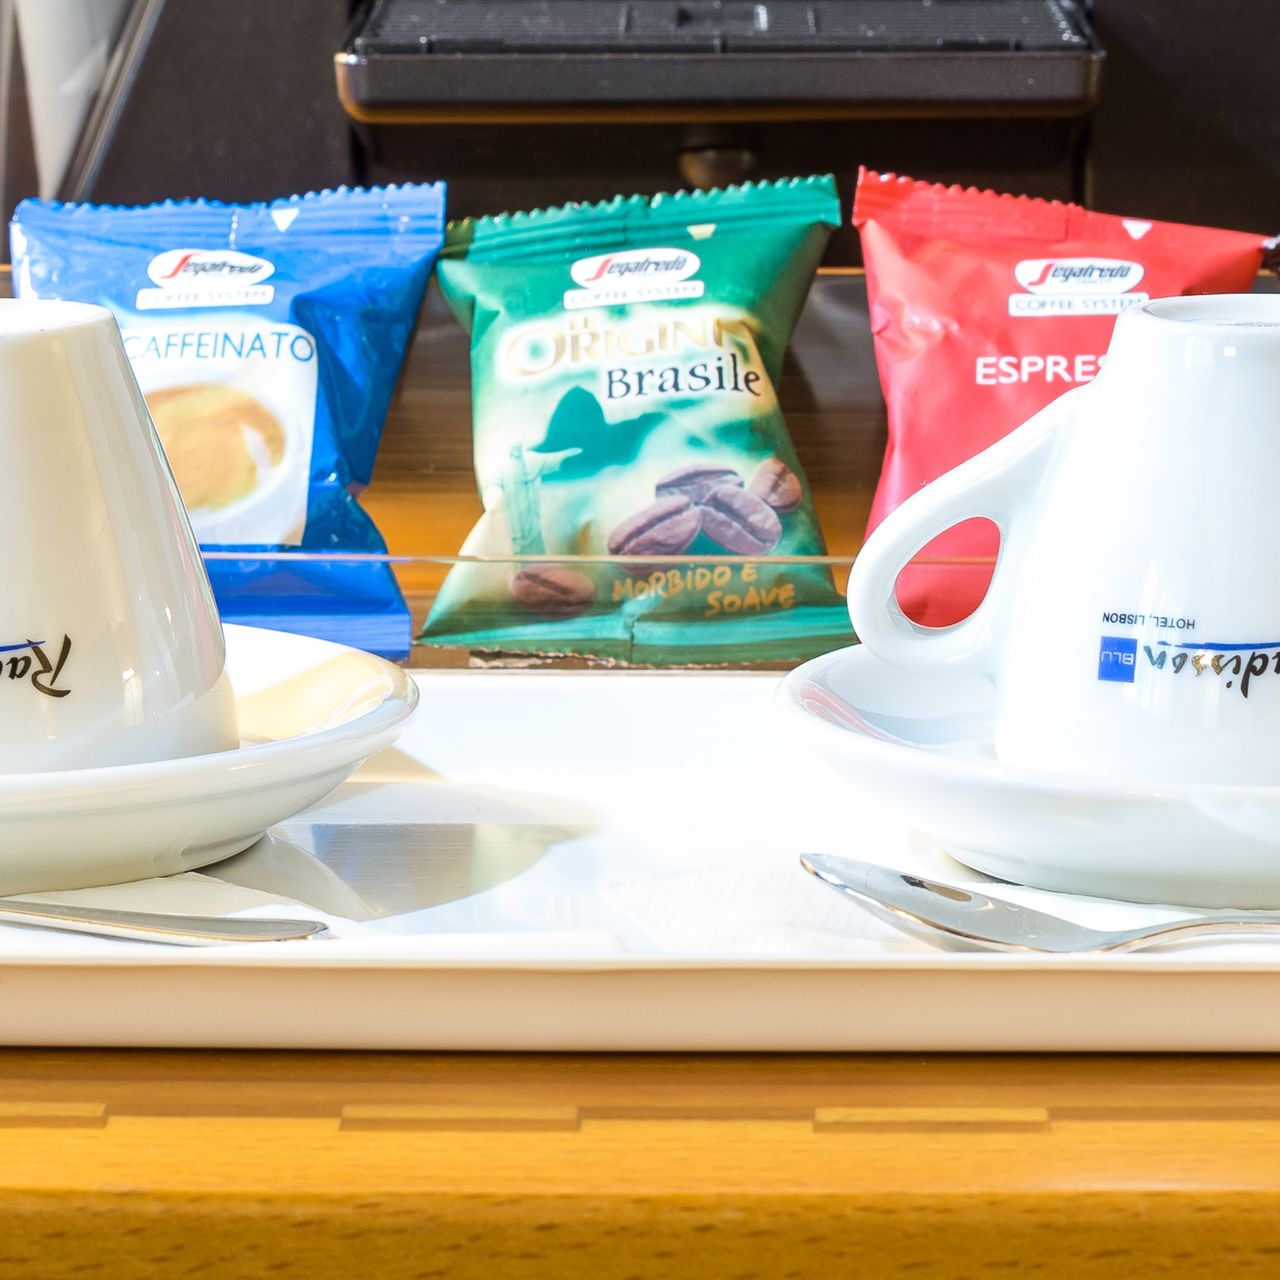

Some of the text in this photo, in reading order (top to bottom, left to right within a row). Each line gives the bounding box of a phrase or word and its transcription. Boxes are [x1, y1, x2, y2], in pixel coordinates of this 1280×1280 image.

[160, 253, 264, 279] Segafredo
[584, 255, 688, 282] Segafredo
[1028, 263, 1132, 286] Segafredo
[1016, 299, 1074, 310] COFFEE
[606, 353, 762, 400] Brasile
[741, 564, 757, 582] E
[705, 583, 795, 618] SOAVE
[1102, 612, 1145, 626] LISBON
[1101, 650, 1135, 666] BLU
